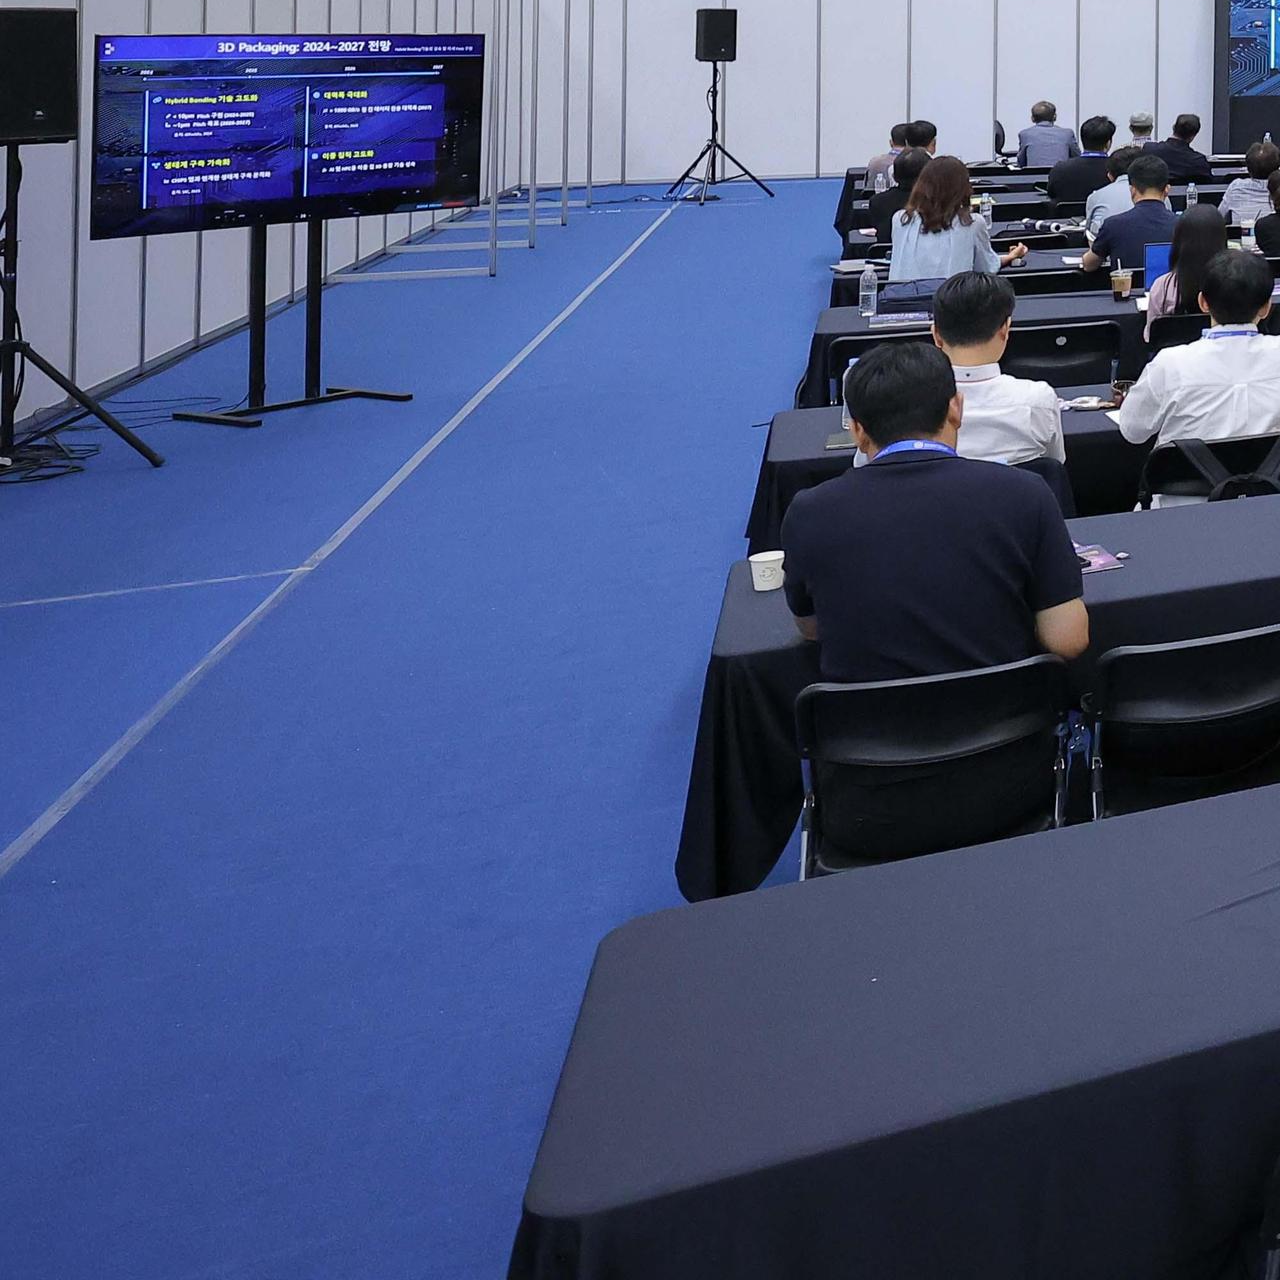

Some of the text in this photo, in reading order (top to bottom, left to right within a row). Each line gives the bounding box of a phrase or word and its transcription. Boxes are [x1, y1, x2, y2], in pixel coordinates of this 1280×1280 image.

[217, 42, 235, 53] 3D
[238, 41, 300, 55] Packaging:
[303, 41, 365, 52] 2024~2027
[368, 40, 392, 52] 전망
